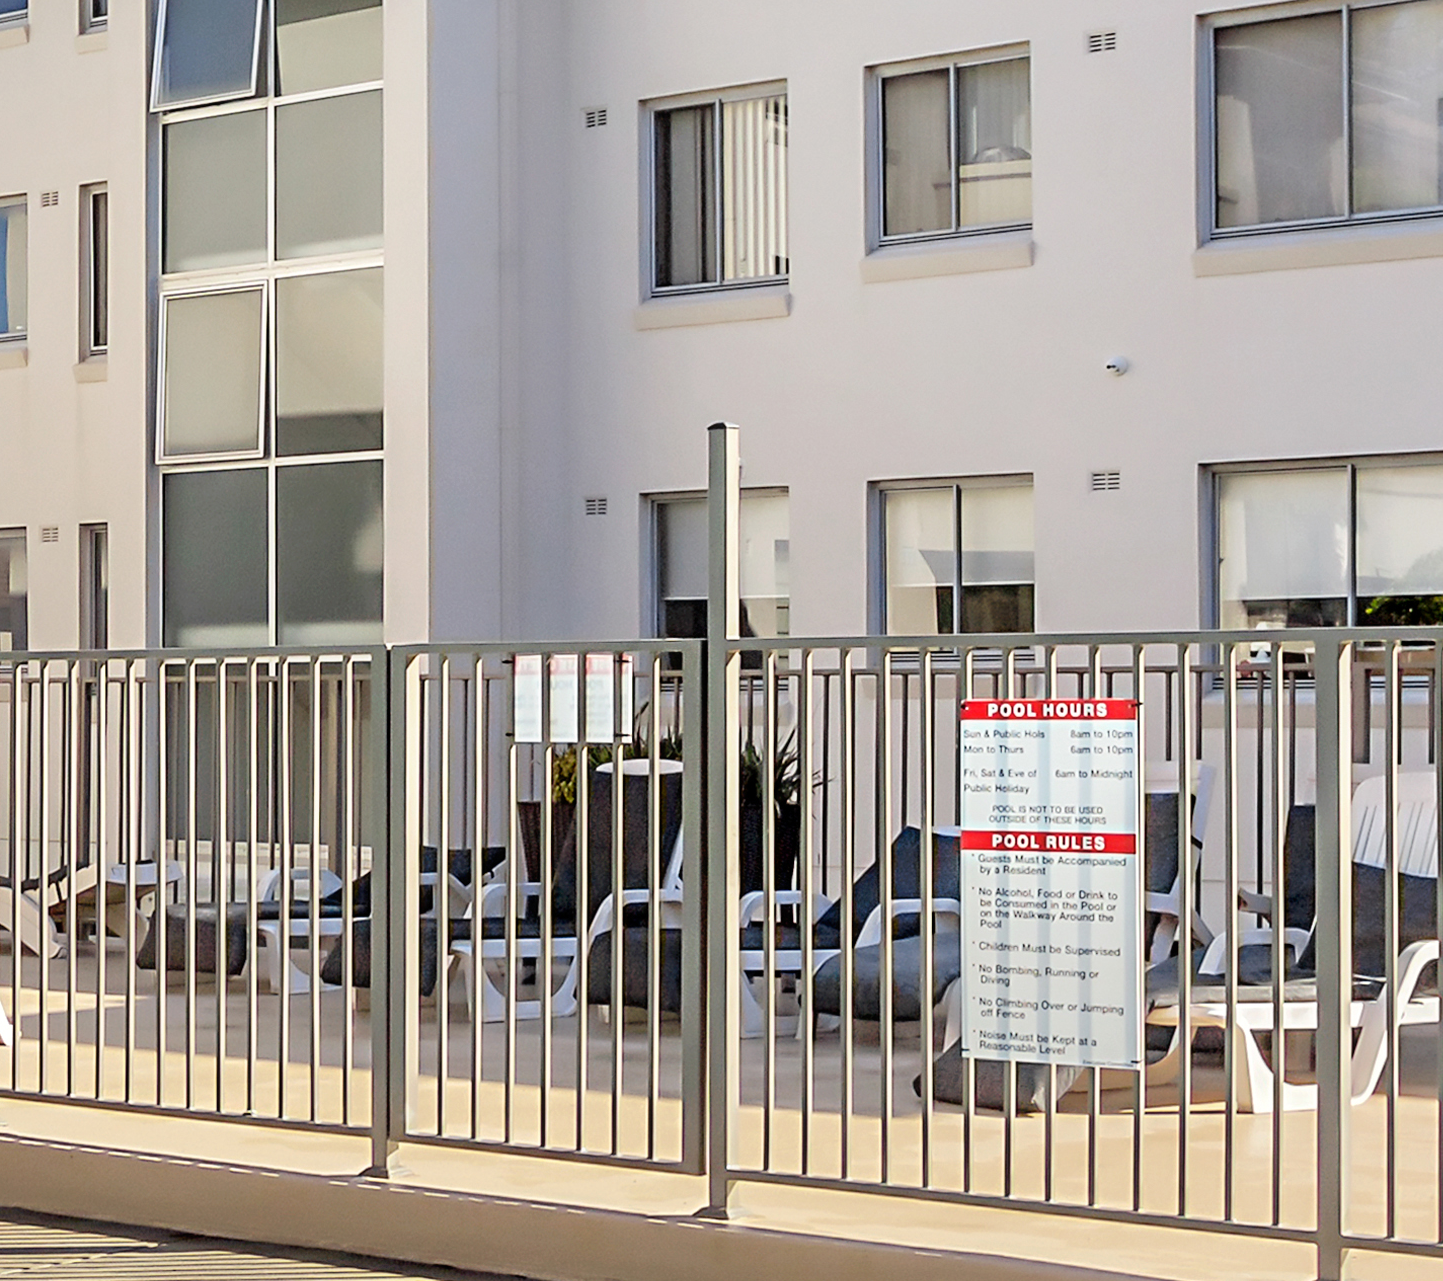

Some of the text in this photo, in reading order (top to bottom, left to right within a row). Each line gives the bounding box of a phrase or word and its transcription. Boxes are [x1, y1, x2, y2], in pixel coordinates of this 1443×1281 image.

[988, 703, 1107, 717] POOL HOURS
[964, 730, 981, 738] Sun
[984, 730, 990, 738] &
[994, 730, 1021, 738] Public
[1025, 730, 1045, 738] Hols
[1070, 730, 1090, 738] 8am
[1107, 730, 1133, 740] 10pm
[999, 745, 1024, 753] Thurs
[1070, 745, 1090, 753] 6am
[1107, 746, 1133, 755] 10pm
[964, 770, 978, 778] Fri,
[999, 769, 1004, 777] &
[1008, 770, 1024, 778] Eve
[1028, 770, 1037, 778] of
[1079, 770, 1087, 778] to
[1091, 770, 1133, 780] Midnight
[964, 784, 1029, 794] Public Holiday
[992, 805, 1015, 813] POOL
[1044, 816, 1072, 824] THESE
[1075, 817, 1106, 825] HOURS
[992, 834, 1105, 850] POOL RULES
[978, 854, 1126, 867] Guests Must be Accompanied
[980, 866, 991, 875] by
[1003, 867, 1046, 875] Resident
[979, 888, 992, 896] No
[995, 888, 1034, 898] Alcohol,
[1038, 889, 1062, 898] Food
[1079, 890, 1103, 899] Drink
[1108, 892, 1117, 900] to
[980, 899, 991, 907] be
[995, 899, 1047, 908] Consumed
[1051, 901, 1059, 909] in
[1062, 901, 1077, 910] the
[1081, 902, 1103, 911] Pool
[995, 909, 1009, 918] the
[1014, 910, 1056, 922] Walkway
[1059, 912, 1095, 922] Around
[1098, 913, 1113, 922] the
[980, 920, 1002, 928] Pool
[979, 942, 1120, 956] Children Must be Supervised
[979, 965, 992, 973] No
[995, 965, 1042, 977] Bombing,
[1045, 967, 1085, 980] Running
[981, 975, 1010, 987] Diving
[979, 997, 992, 1006] No
[995, 998, 1038, 1010] Climbing
[1041, 1000, 1064, 1010] Over
[1081, 1004, 1124, 1016] Jumping
[981, 1009, 1025, 1019] off Fence
[980, 1030, 1006, 1040] Noise
[1010, 1032, 1034, 1042] Must
[1037, 1034, 1048, 1043] be
[1053, 1035, 1075, 1045] Kept
[1079, 1038, 1088, 1046] at
[980, 1041, 1065, 1055] Reasonable Level
